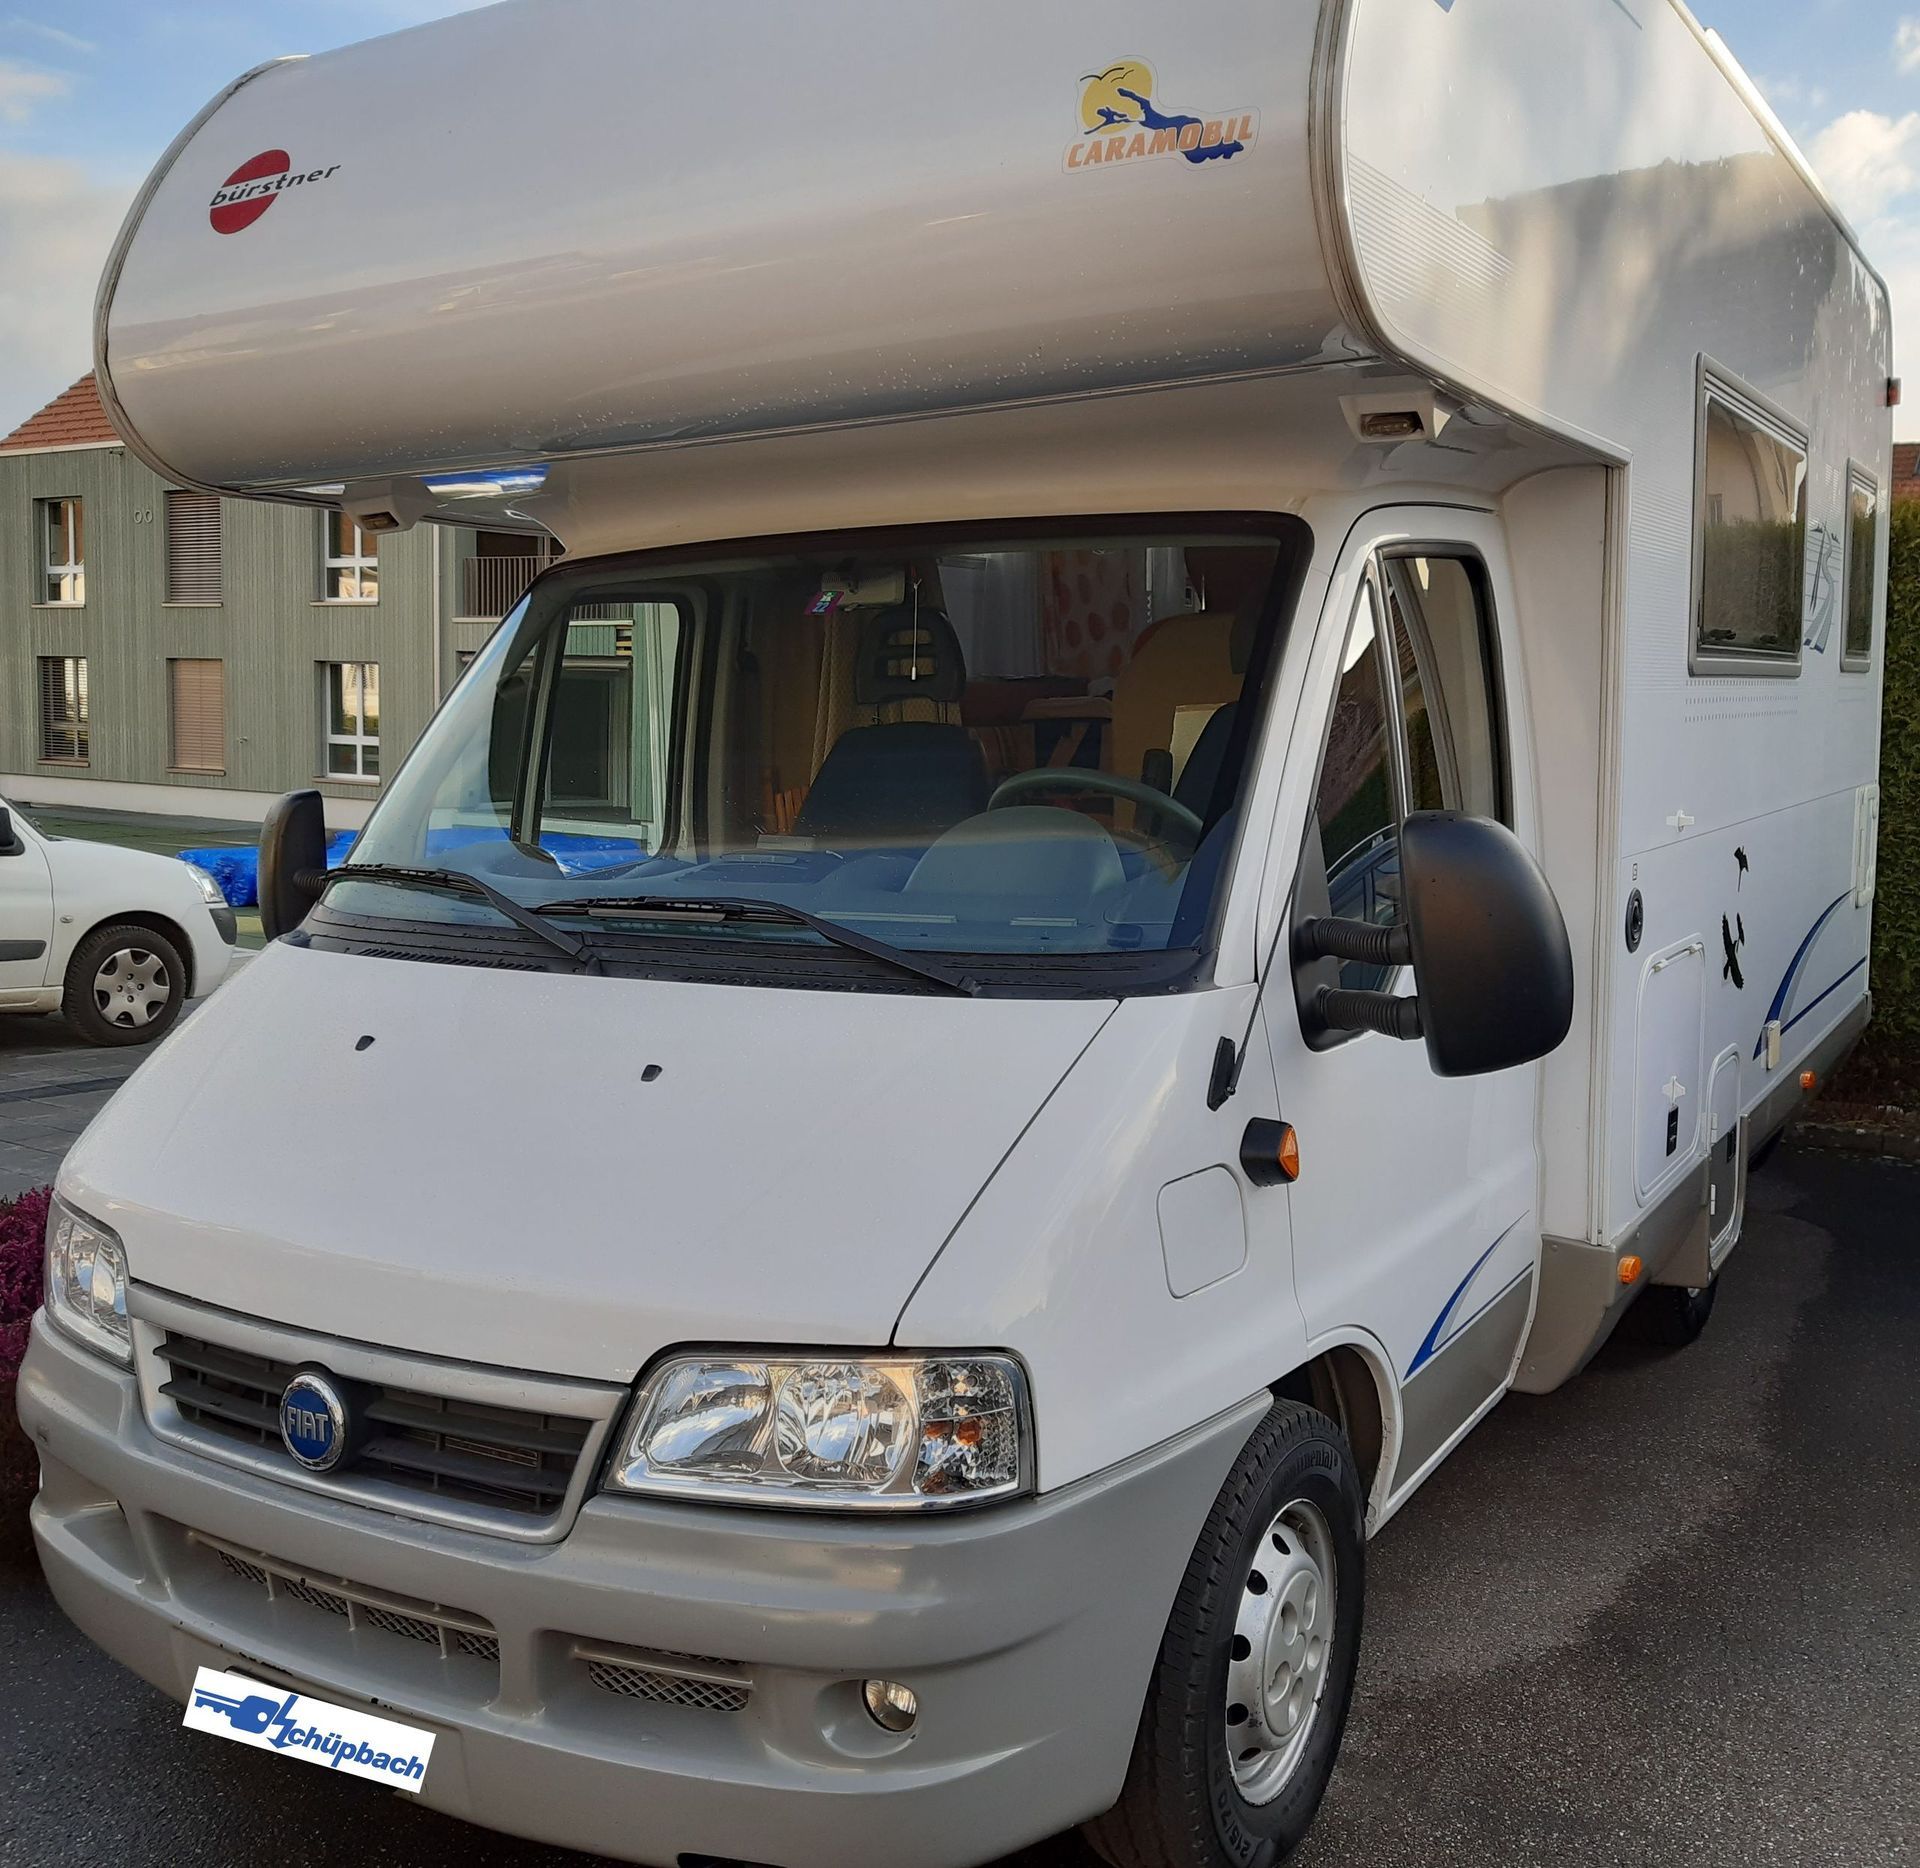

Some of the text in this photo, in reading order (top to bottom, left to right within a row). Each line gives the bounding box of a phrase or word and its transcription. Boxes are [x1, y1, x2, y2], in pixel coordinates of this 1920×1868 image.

[1068, 115, 1253, 168] CARAMOBIL
[209, 165, 341, 207] bürstner
[811, 602, 830, 613] 22
[286, 1406, 329, 1442] FIAT
